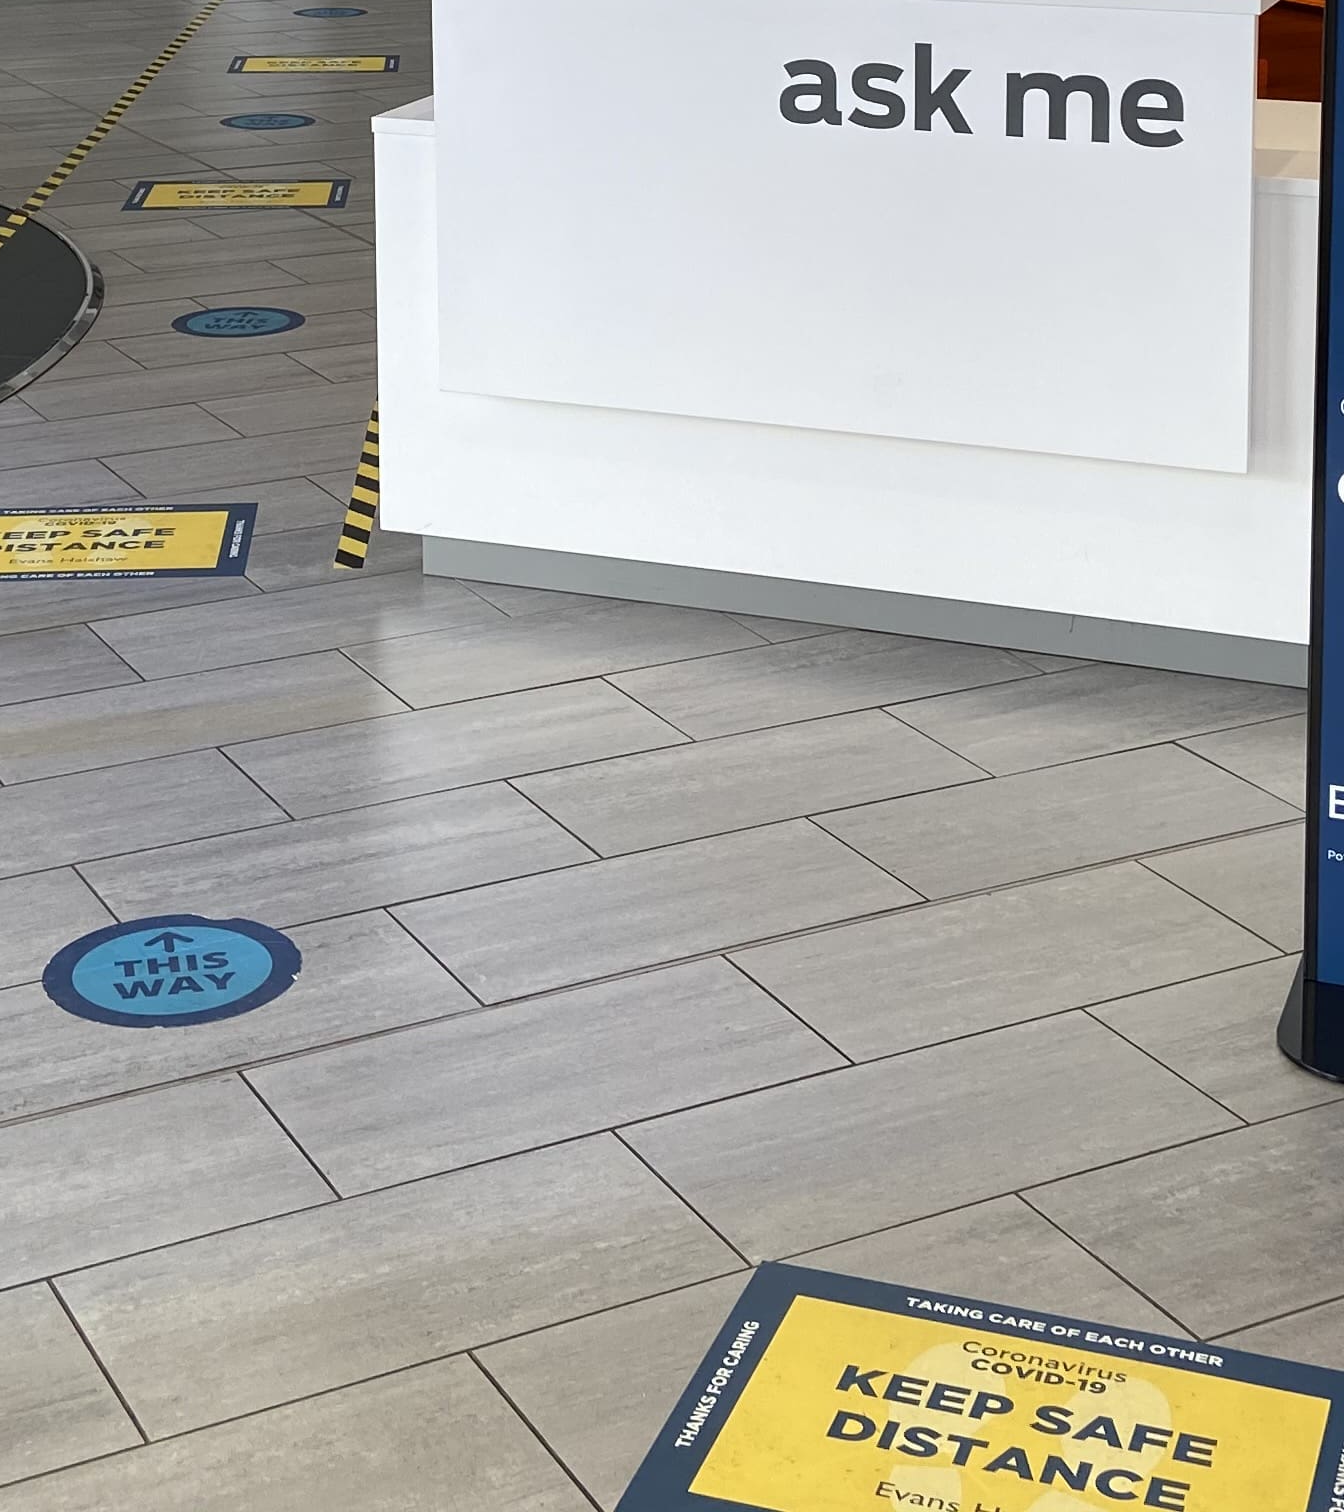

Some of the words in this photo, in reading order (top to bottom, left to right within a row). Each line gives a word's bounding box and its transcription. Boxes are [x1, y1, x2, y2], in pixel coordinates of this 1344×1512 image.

[779, 42, 974, 135] ask
[1005, 72, 1185, 148] me
[81, 528, 176, 538] SAFE
[113, 972, 236, 1000] WAY
[114, 952, 229, 977] THIS
[906, 1296, 984, 1320] TAKING
[989, 1313, 1046, 1333] CARE
[1050, 1324, 1081, 1338] OF
[1085, 1332, 1145, 1352] EACH
[1149, 1344, 1224, 1368] OTHER
[962, 1340, 1128, 1384] Coronavirus
[971, 1359, 1107, 1394] COVID-19
[674, 1394, 717, 1449] THANKS
[706, 1367, 733, 1395] FOR
[722, 1320, 760, 1367] CARING
[835, 1364, 1014, 1420] KEEP
[1029, 1404, 1218, 1468] SAFE
[826, 1409, 1191, 1512] DISTANCE
[875, 1481, 960, 1512] Evans
